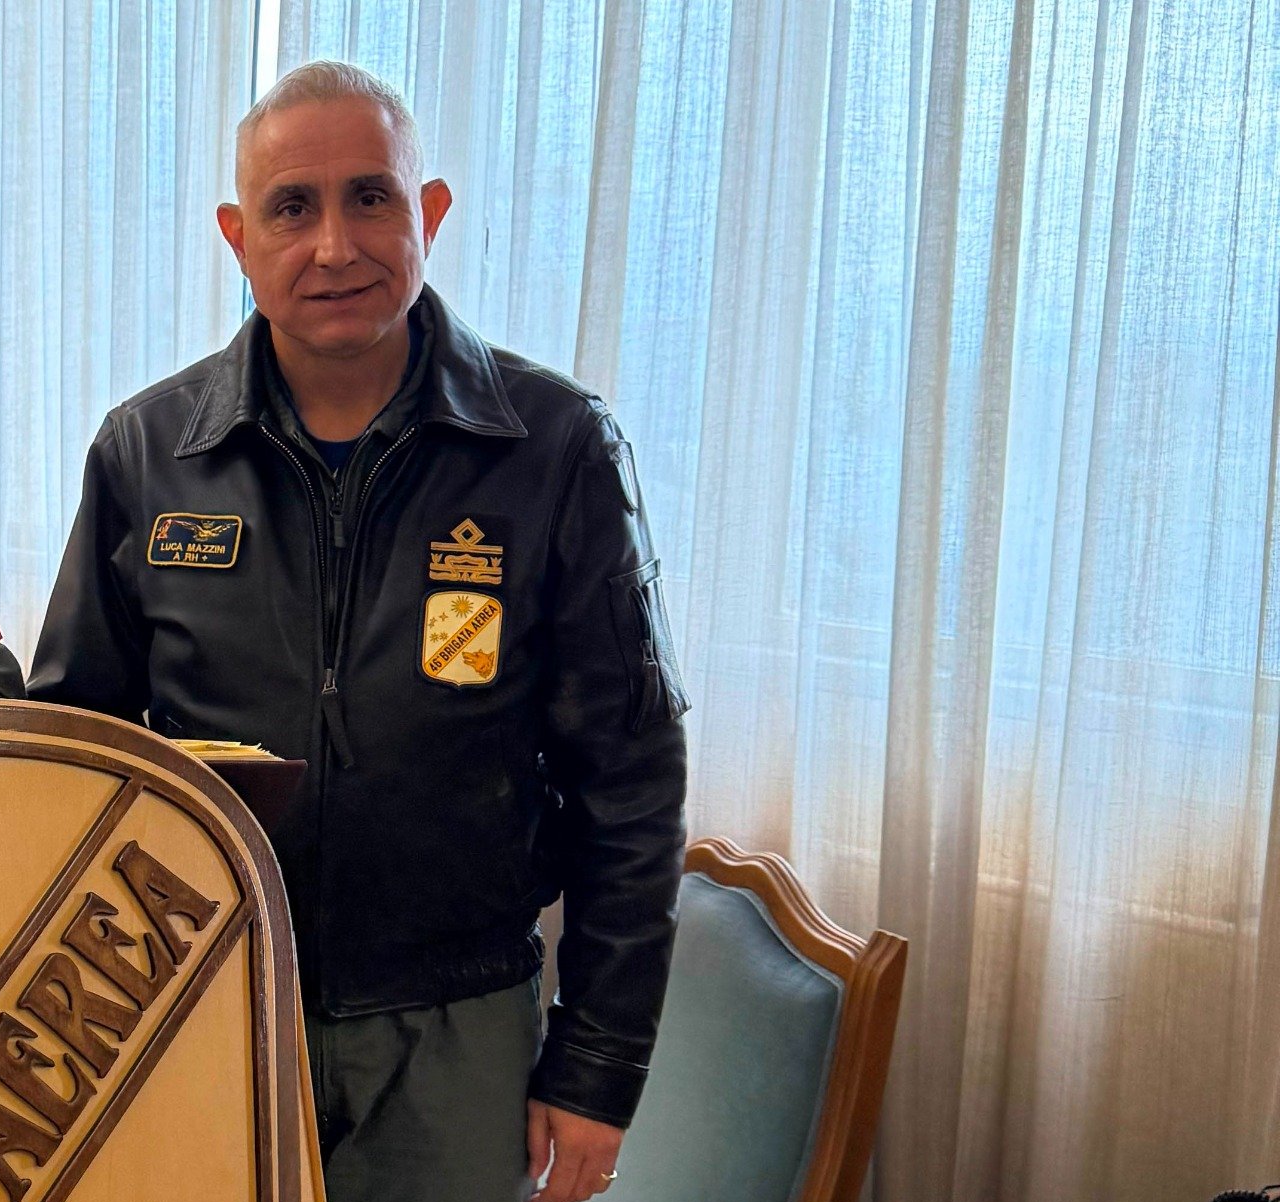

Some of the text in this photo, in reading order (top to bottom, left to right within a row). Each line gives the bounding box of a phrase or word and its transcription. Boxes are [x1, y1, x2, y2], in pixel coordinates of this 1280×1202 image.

[160, 542, 226, 554] LUCA MAZZINI
[183, 552, 198, 562] RH
[439, 628, 474, 662] BRIGATA
[471, 604, 498, 631] AEREA
